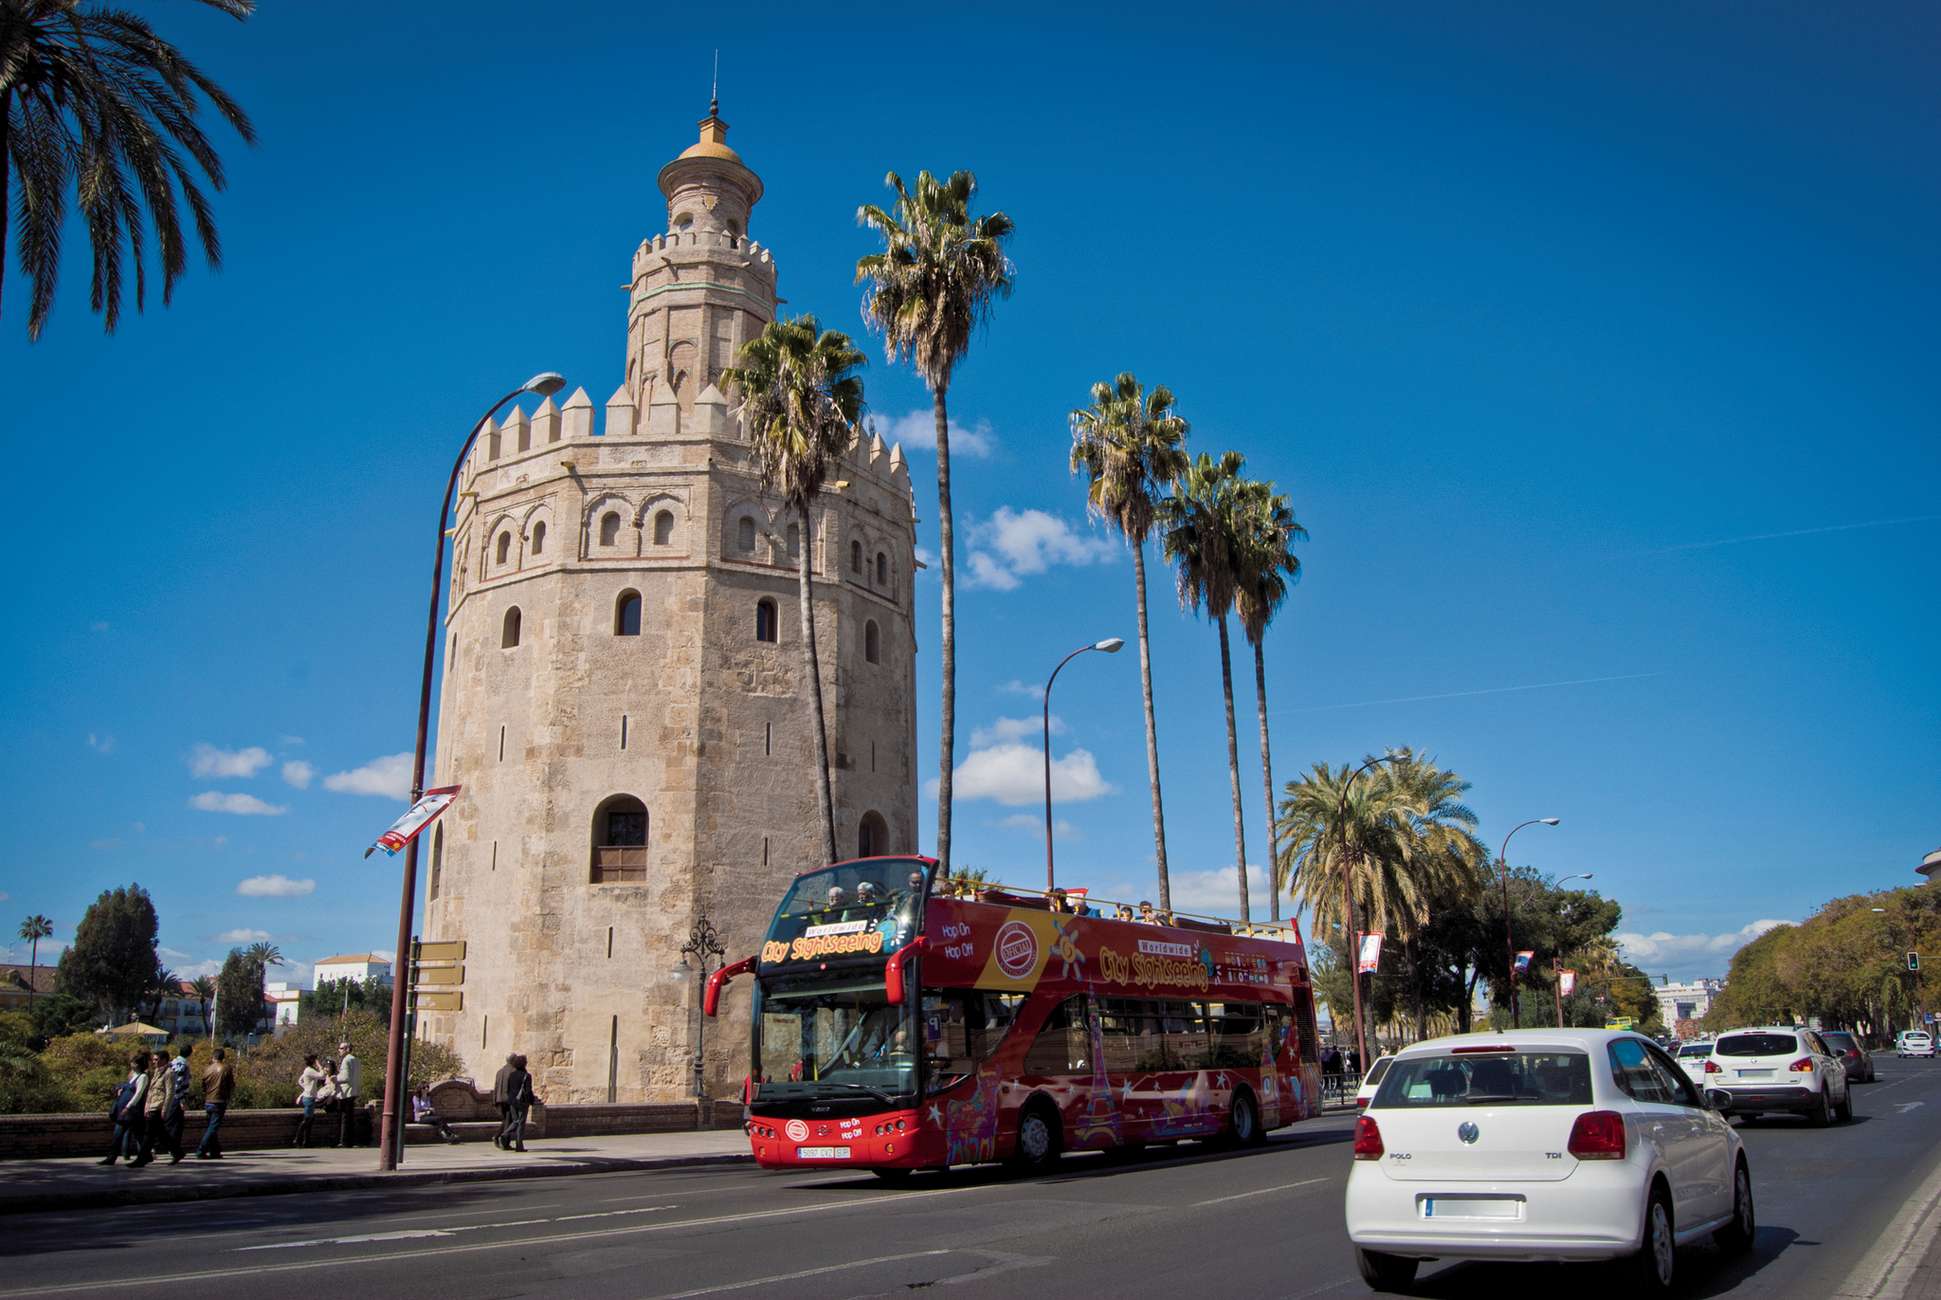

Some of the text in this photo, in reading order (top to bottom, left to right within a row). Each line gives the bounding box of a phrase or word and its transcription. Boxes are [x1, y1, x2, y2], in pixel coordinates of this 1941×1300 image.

[761, 931, 884, 964] City Sightseeing
[944, 944, 961, 960] Hop
[1141, 942, 1190, 956] Worldwide
[1099, 945, 1129, 986] City
[1131, 951, 1209, 992] Sightseeing
[1389, 1152, 1412, 1160] POLO
[1544, 1152, 1562, 1160] TDI
